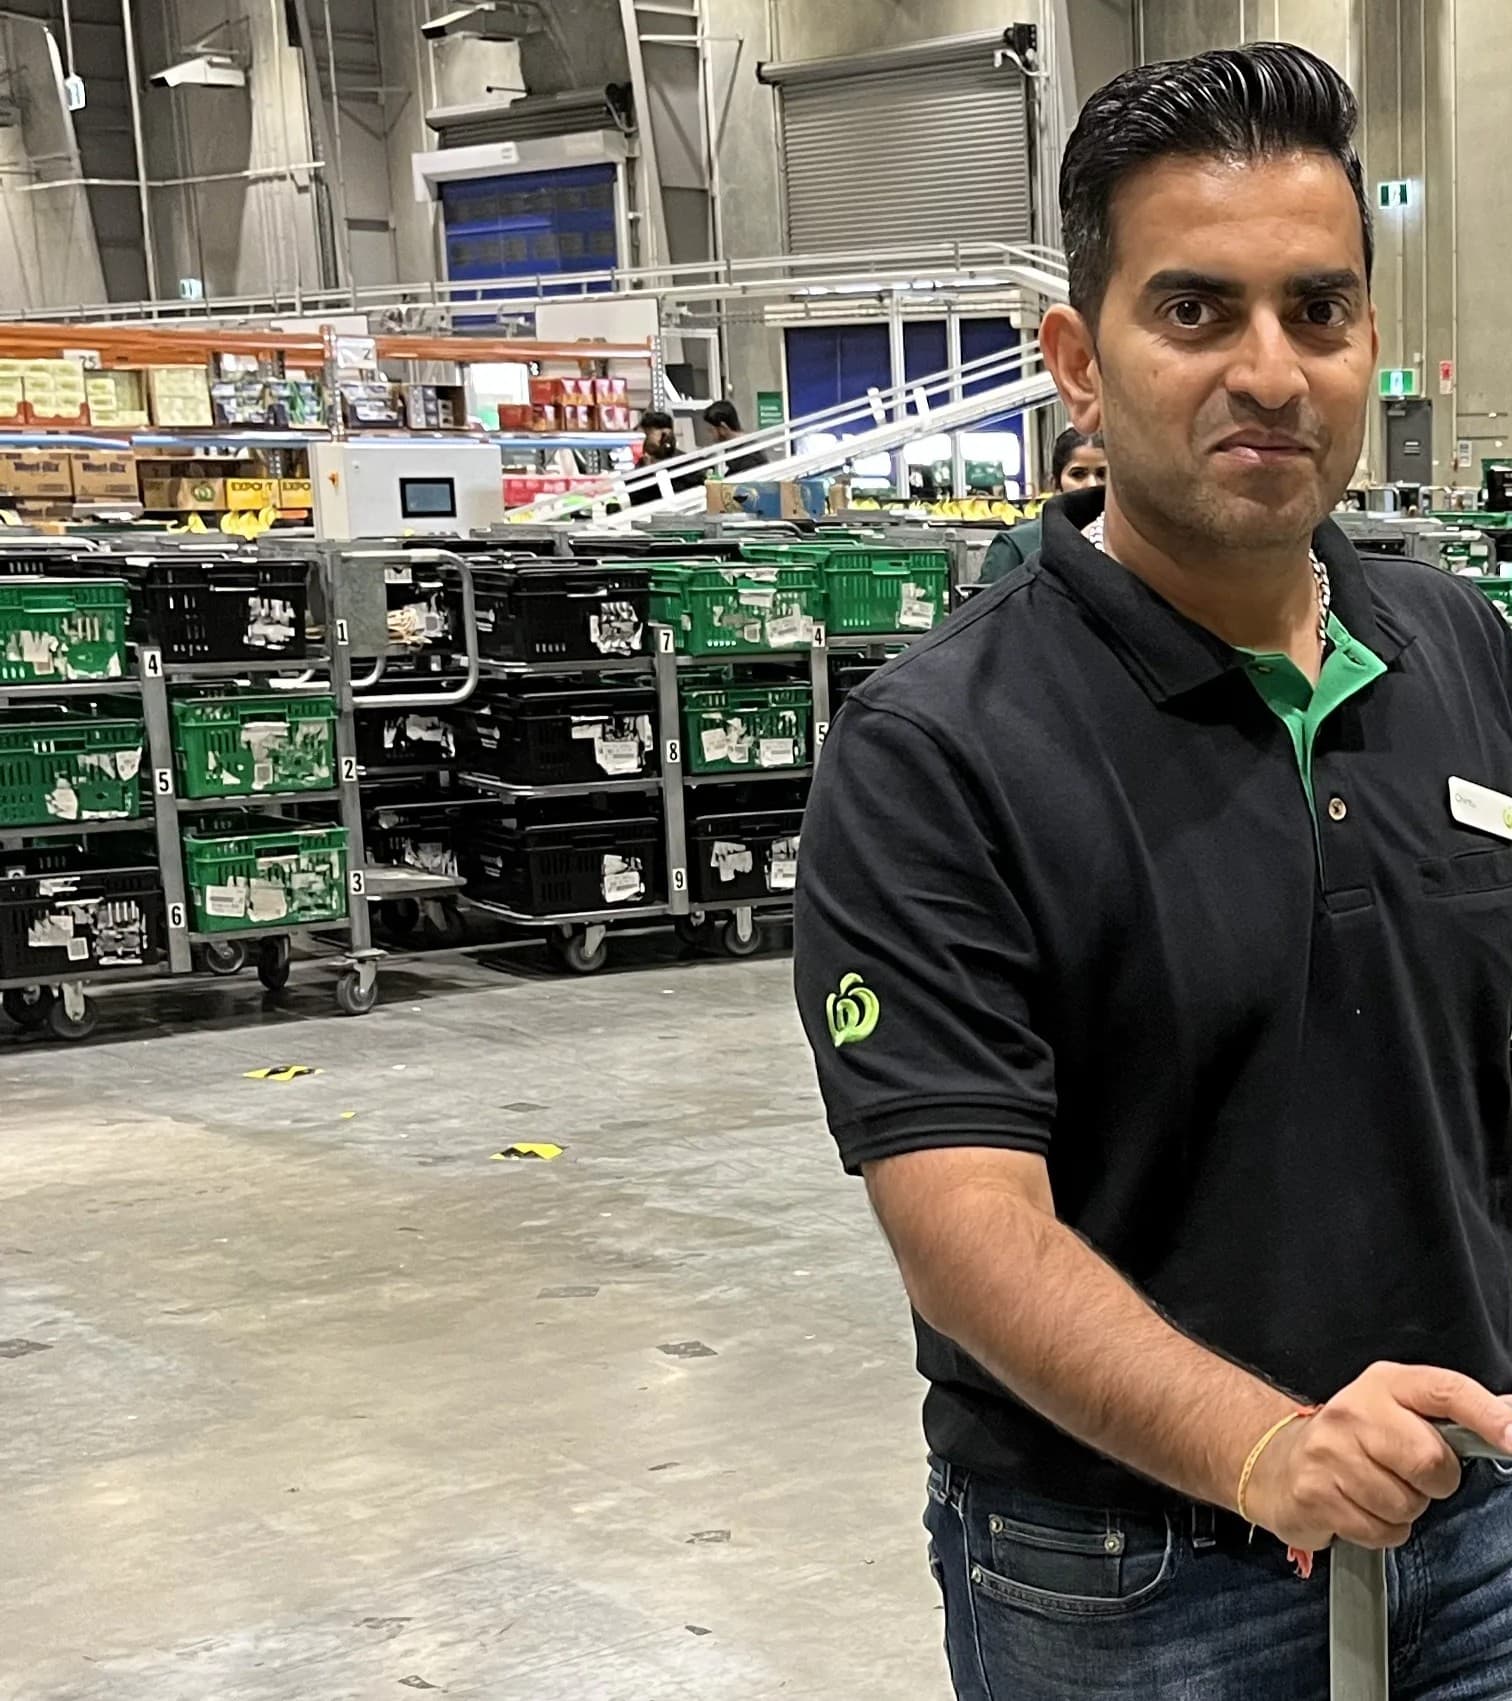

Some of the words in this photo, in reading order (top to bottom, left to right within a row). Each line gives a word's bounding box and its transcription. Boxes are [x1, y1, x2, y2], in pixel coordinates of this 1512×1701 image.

[231, 482, 273, 491] EXPOT
[338, 623, 347, 642] 1
[662, 632, 671, 651] 7
[815, 628, 823, 645] 4
[149, 654, 158, 674] 4
[818, 724, 826, 742] 5
[669, 742, 678, 761] 8
[344, 760, 354, 779] 2
[159, 772, 169, 792] 5
[352, 873, 362, 892] 3
[675, 871, 683, 889] 9
[171, 905, 181, 926] 6
